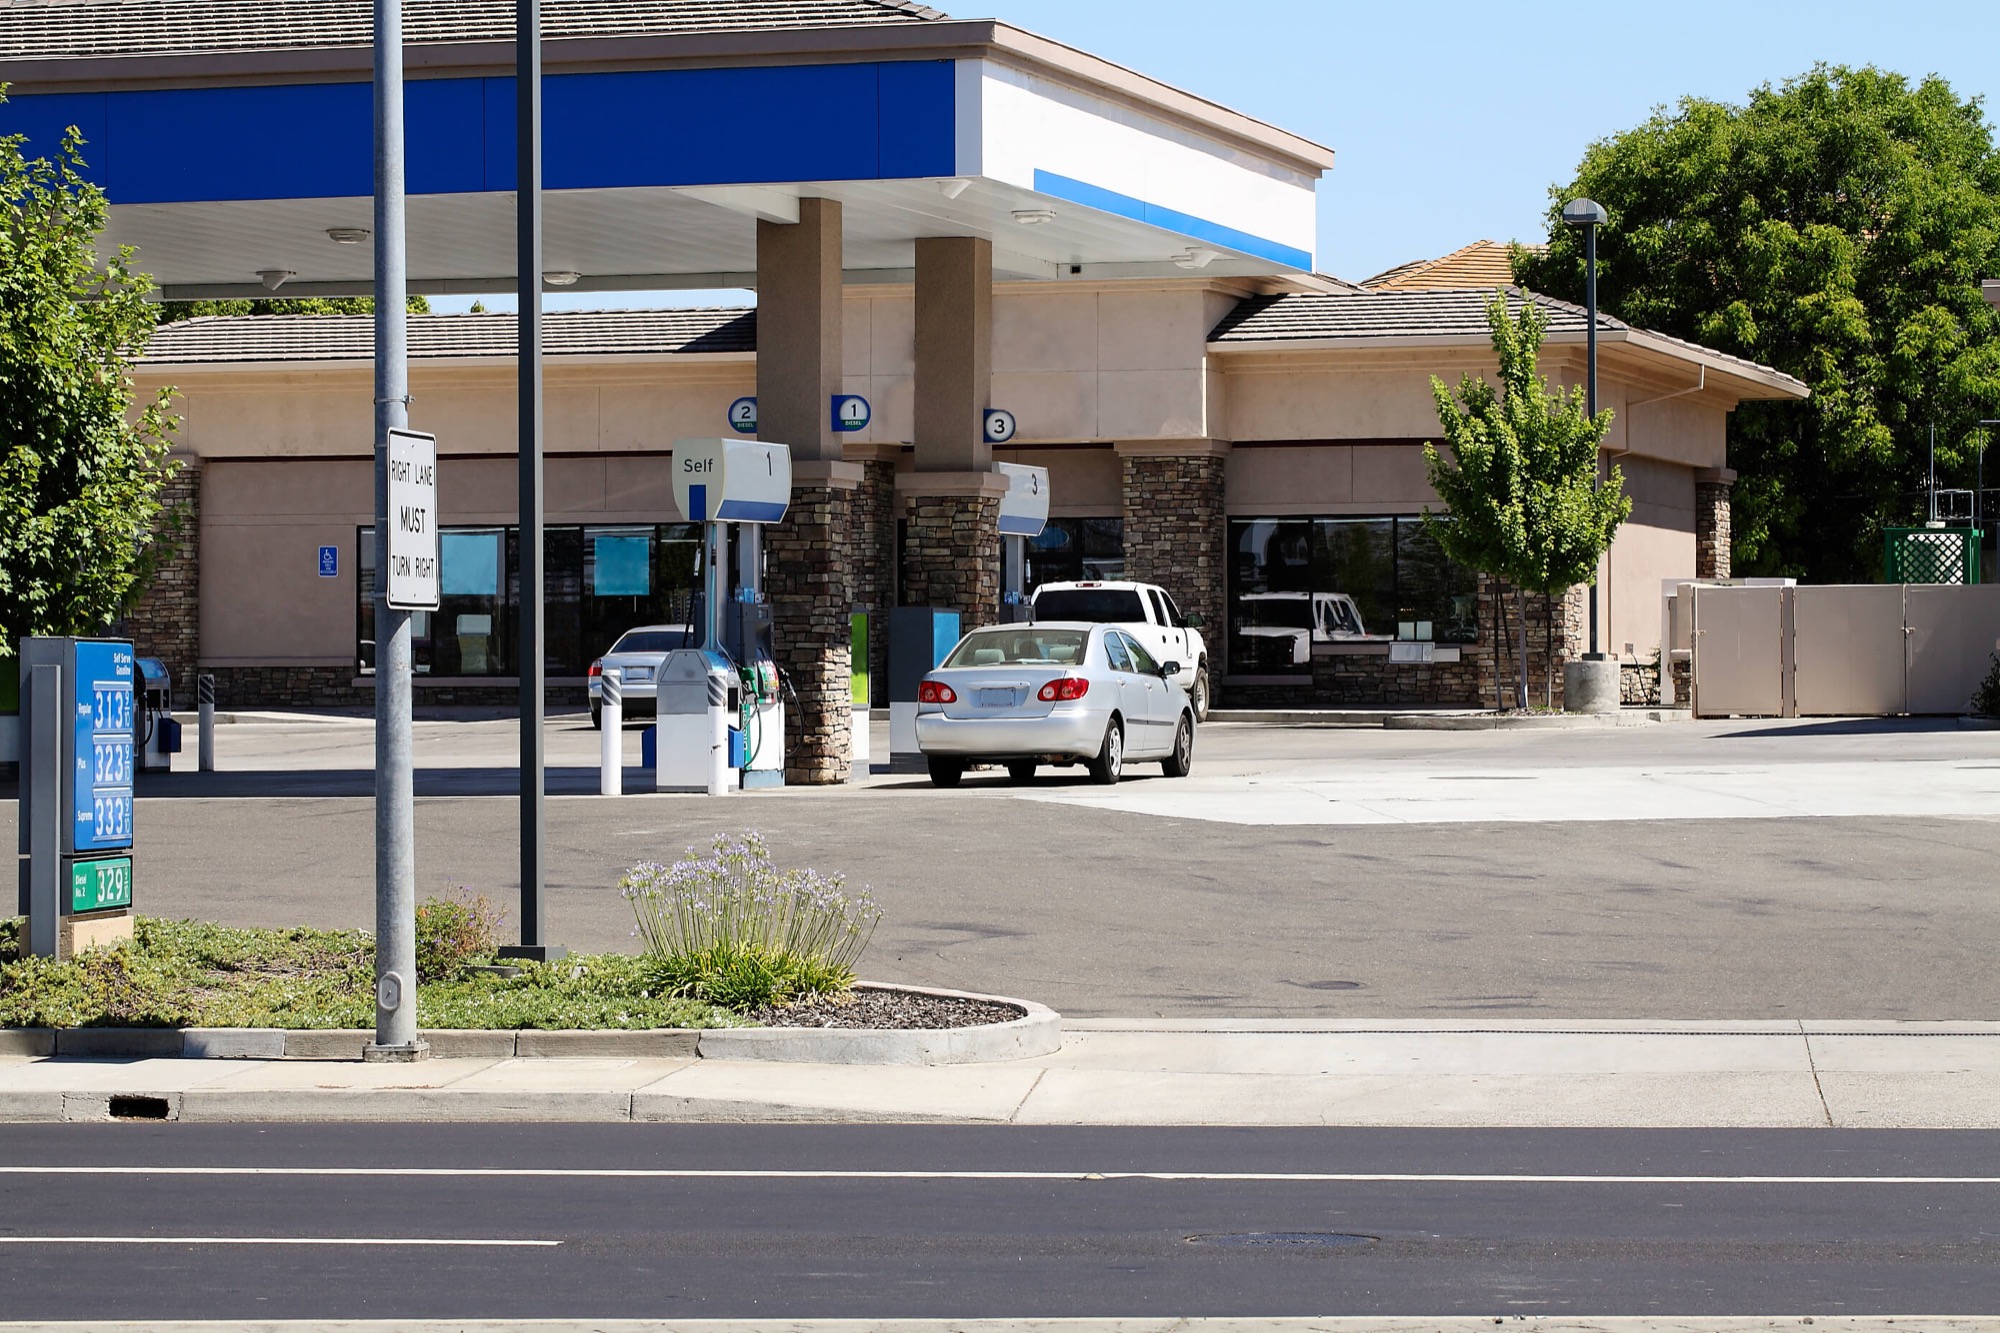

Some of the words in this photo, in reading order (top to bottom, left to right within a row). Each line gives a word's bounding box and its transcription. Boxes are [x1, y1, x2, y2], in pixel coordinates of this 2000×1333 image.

[741, 406, 751, 419] 2
[851, 403, 856, 417] 1
[994, 419, 1005, 434] 3
[683, 458, 713, 473] Self
[766, 451, 772, 476] 1
[391, 460, 411, 482] RIGHT
[415, 463, 433, 486] LANE
[1031, 473, 1038, 495] 3
[400, 505, 426, 534] MUST
[392, 555, 411, 577] TURN
[415, 557, 434, 579] RIGHT
[78, 702, 92, 716] Regular
[77, 758, 86, 769] Plus
[77, 810, 93, 823] Supreme
[75, 873, 87, 885] Diesel
